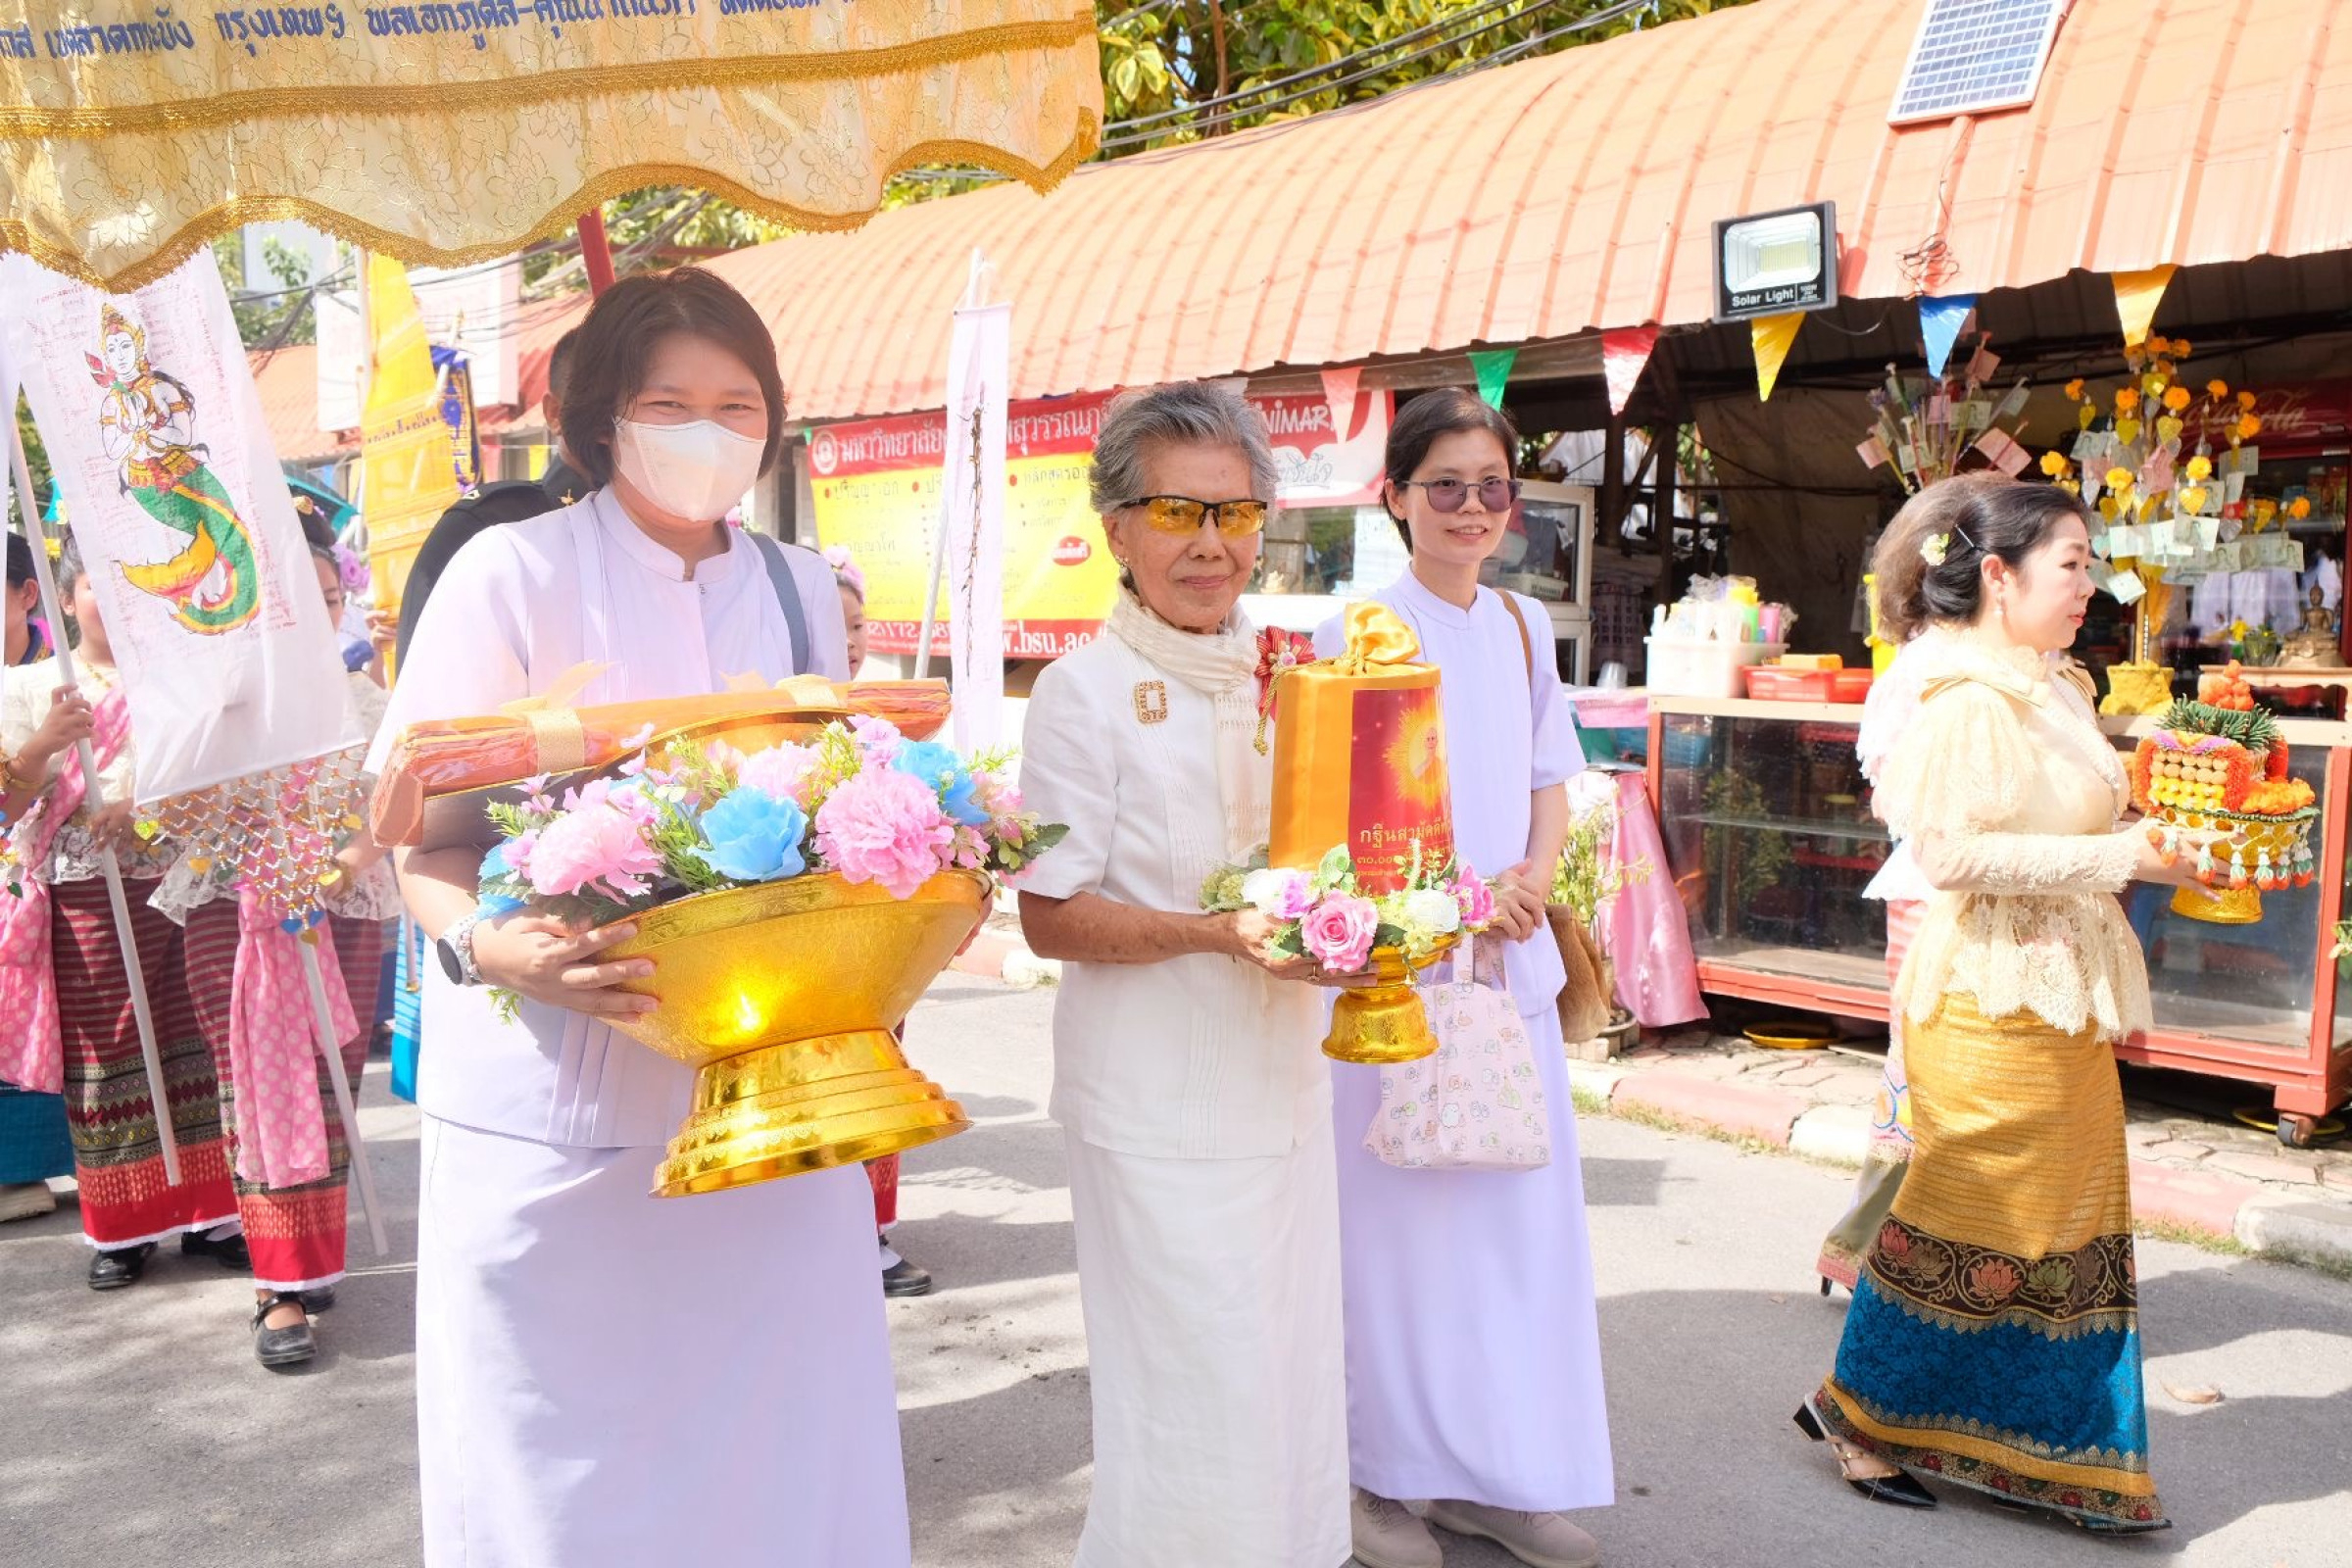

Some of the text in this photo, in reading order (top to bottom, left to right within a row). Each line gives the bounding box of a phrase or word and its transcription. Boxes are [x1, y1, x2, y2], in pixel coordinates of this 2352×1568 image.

[215, 4, 345, 57] กรุงเทพฯ
[1732, 294, 1761, 307] Solar
[1765, 287, 1794, 304] Light
